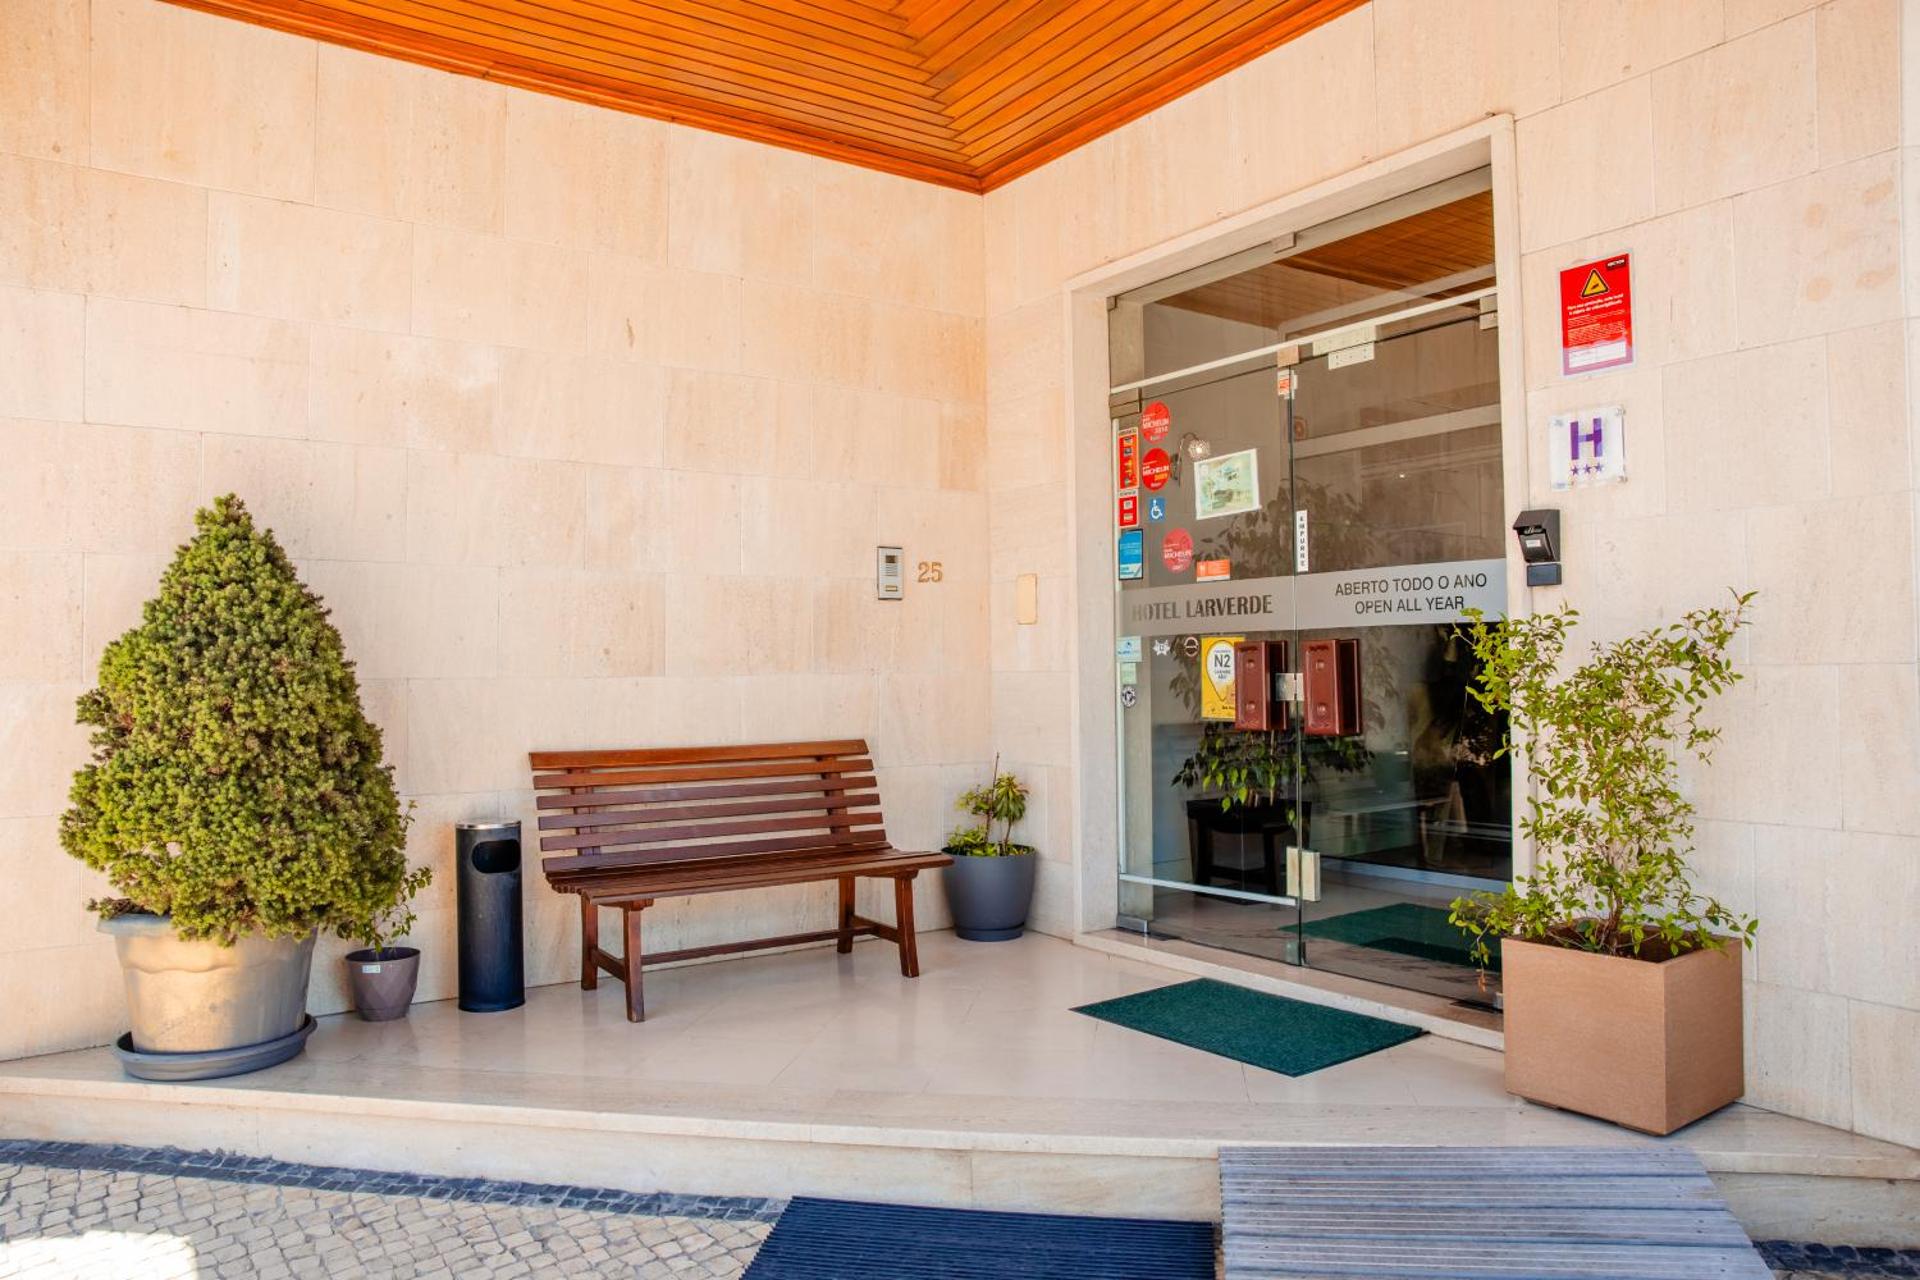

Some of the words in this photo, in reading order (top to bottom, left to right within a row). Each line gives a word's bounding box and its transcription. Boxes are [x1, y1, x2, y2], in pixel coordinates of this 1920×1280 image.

[1570, 418, 1603, 460] H
[918, 561, 943, 583] 25
[1335, 578, 1389, 596] ABERTO
[1392, 576, 1434, 592] TODO
[1438, 575, 1450, 590] O
[1453, 572, 1488, 589] ANO
[1132, 602, 1181, 621] HOTEL
[1186, 594, 1273, 618] LARVERDE
[1354, 599, 1393, 615] OPEN
[1396, 598, 1422, 612] ALL
[1425, 595, 1465, 611] YEAR
[1214, 654, 1231, 668] N2
